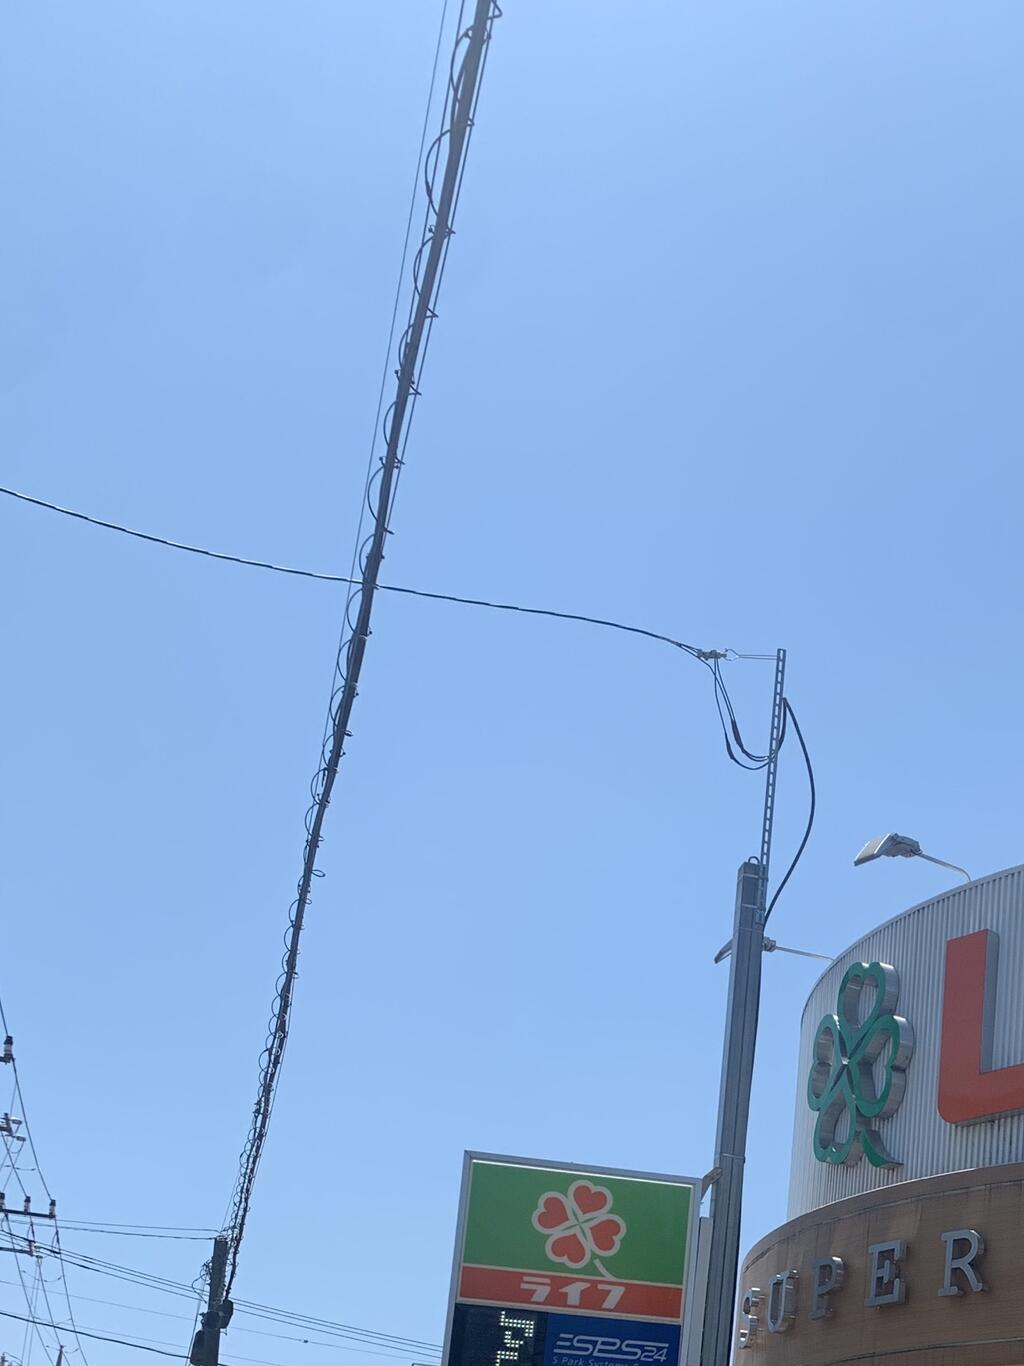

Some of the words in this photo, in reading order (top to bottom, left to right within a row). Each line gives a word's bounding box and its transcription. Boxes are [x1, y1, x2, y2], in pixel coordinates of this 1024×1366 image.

[519, 1276, 626, 1310] ライフ
[561, 1356, 585, 1366] Park
